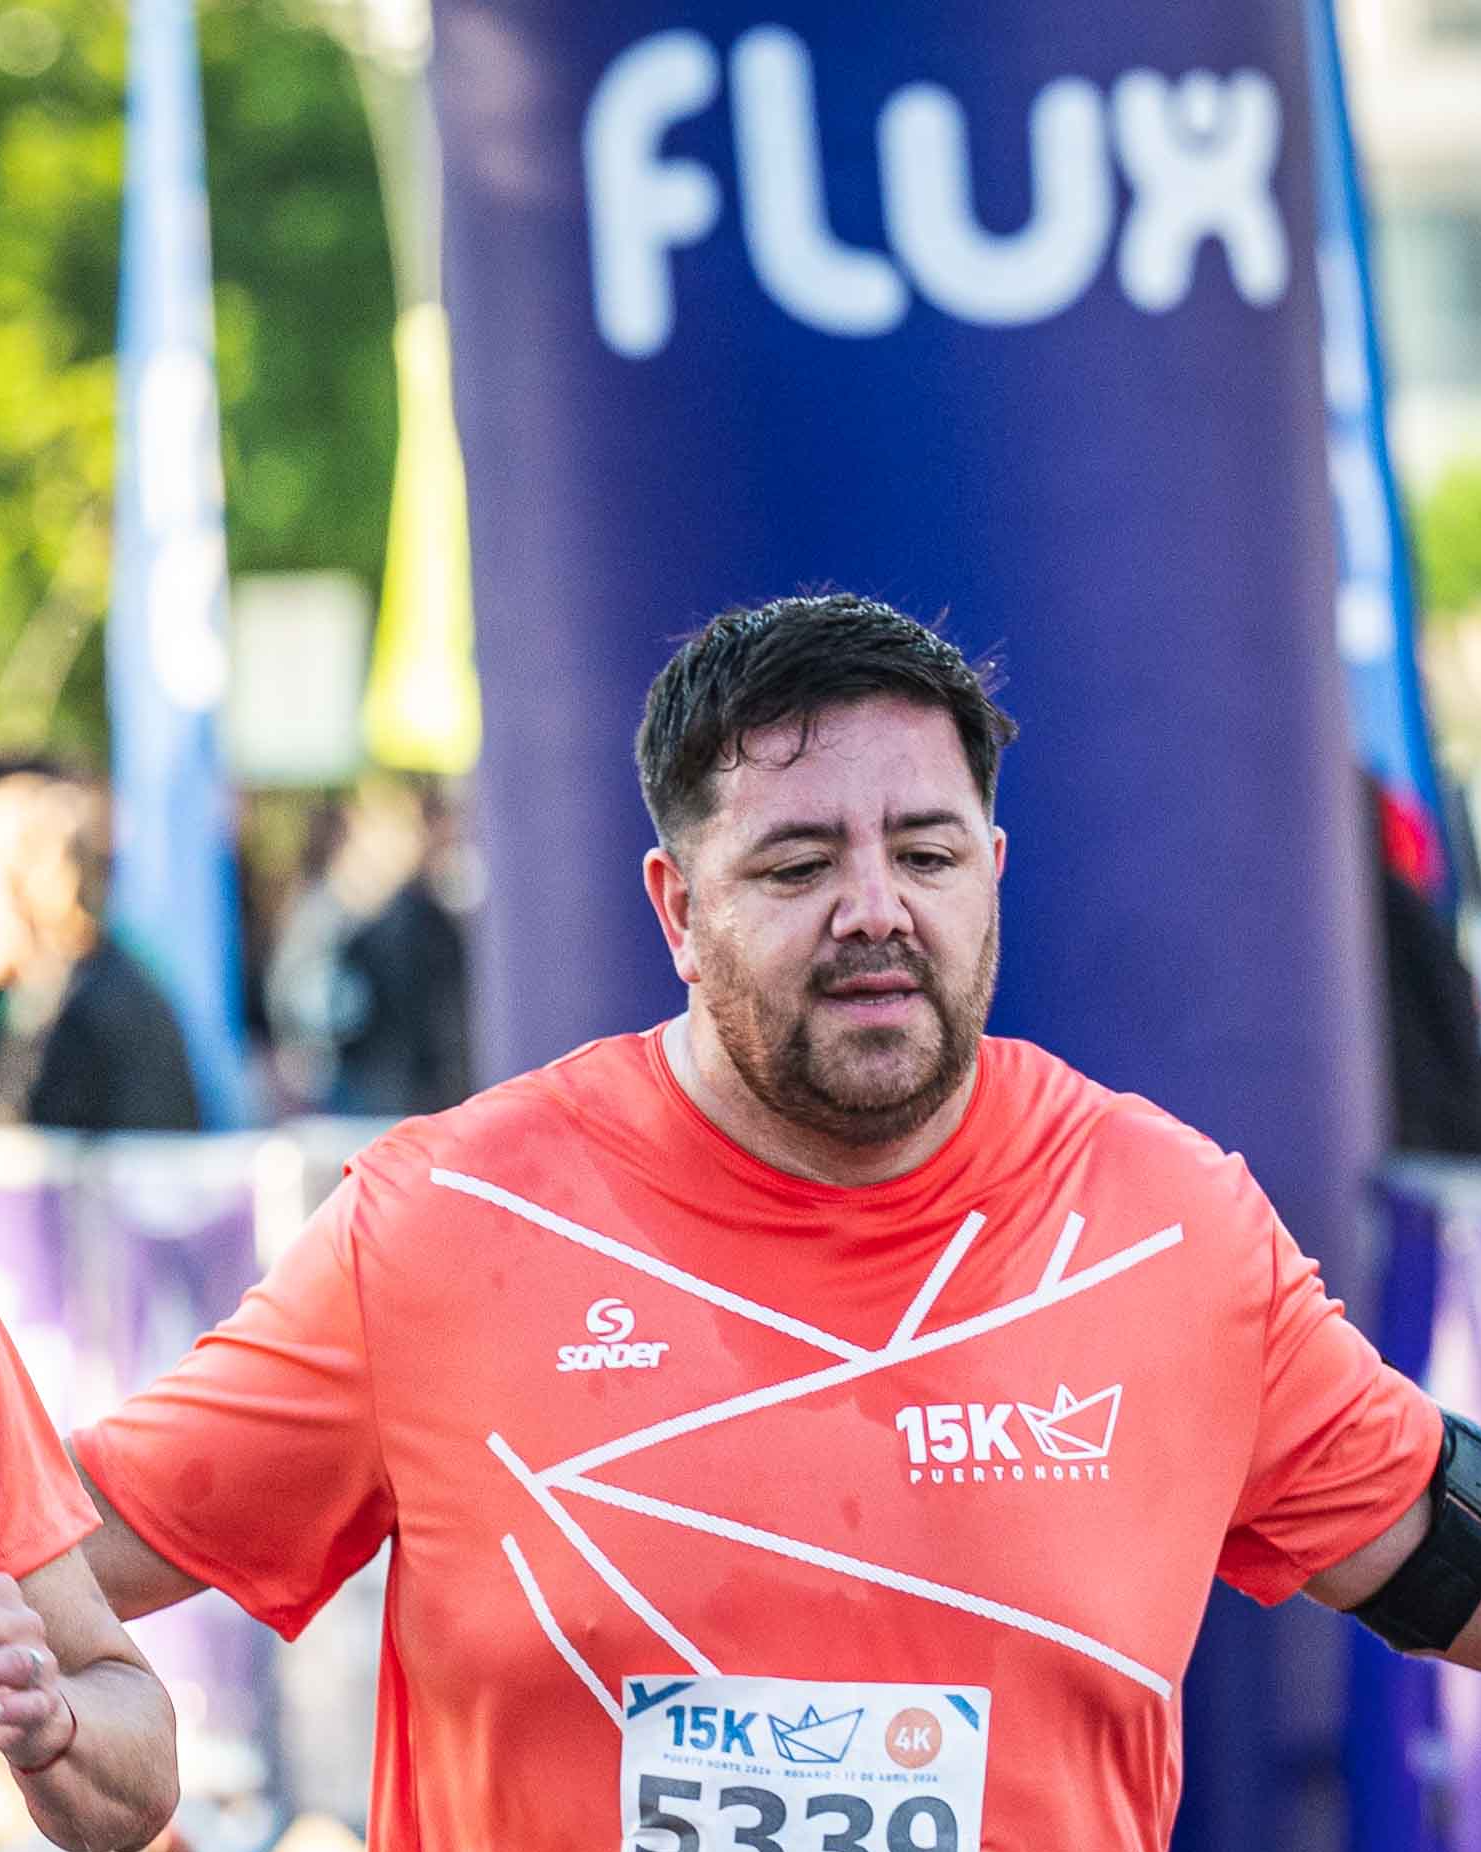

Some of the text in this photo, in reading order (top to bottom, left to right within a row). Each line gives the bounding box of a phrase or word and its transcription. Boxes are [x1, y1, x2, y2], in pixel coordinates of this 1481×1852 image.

[895, 1403, 1022, 1464] 15K
[910, 1464, 1110, 1485] PUERTO NORTE
[664, 1704, 758, 1757] 15K
[894, 1727, 932, 1751] 4K
